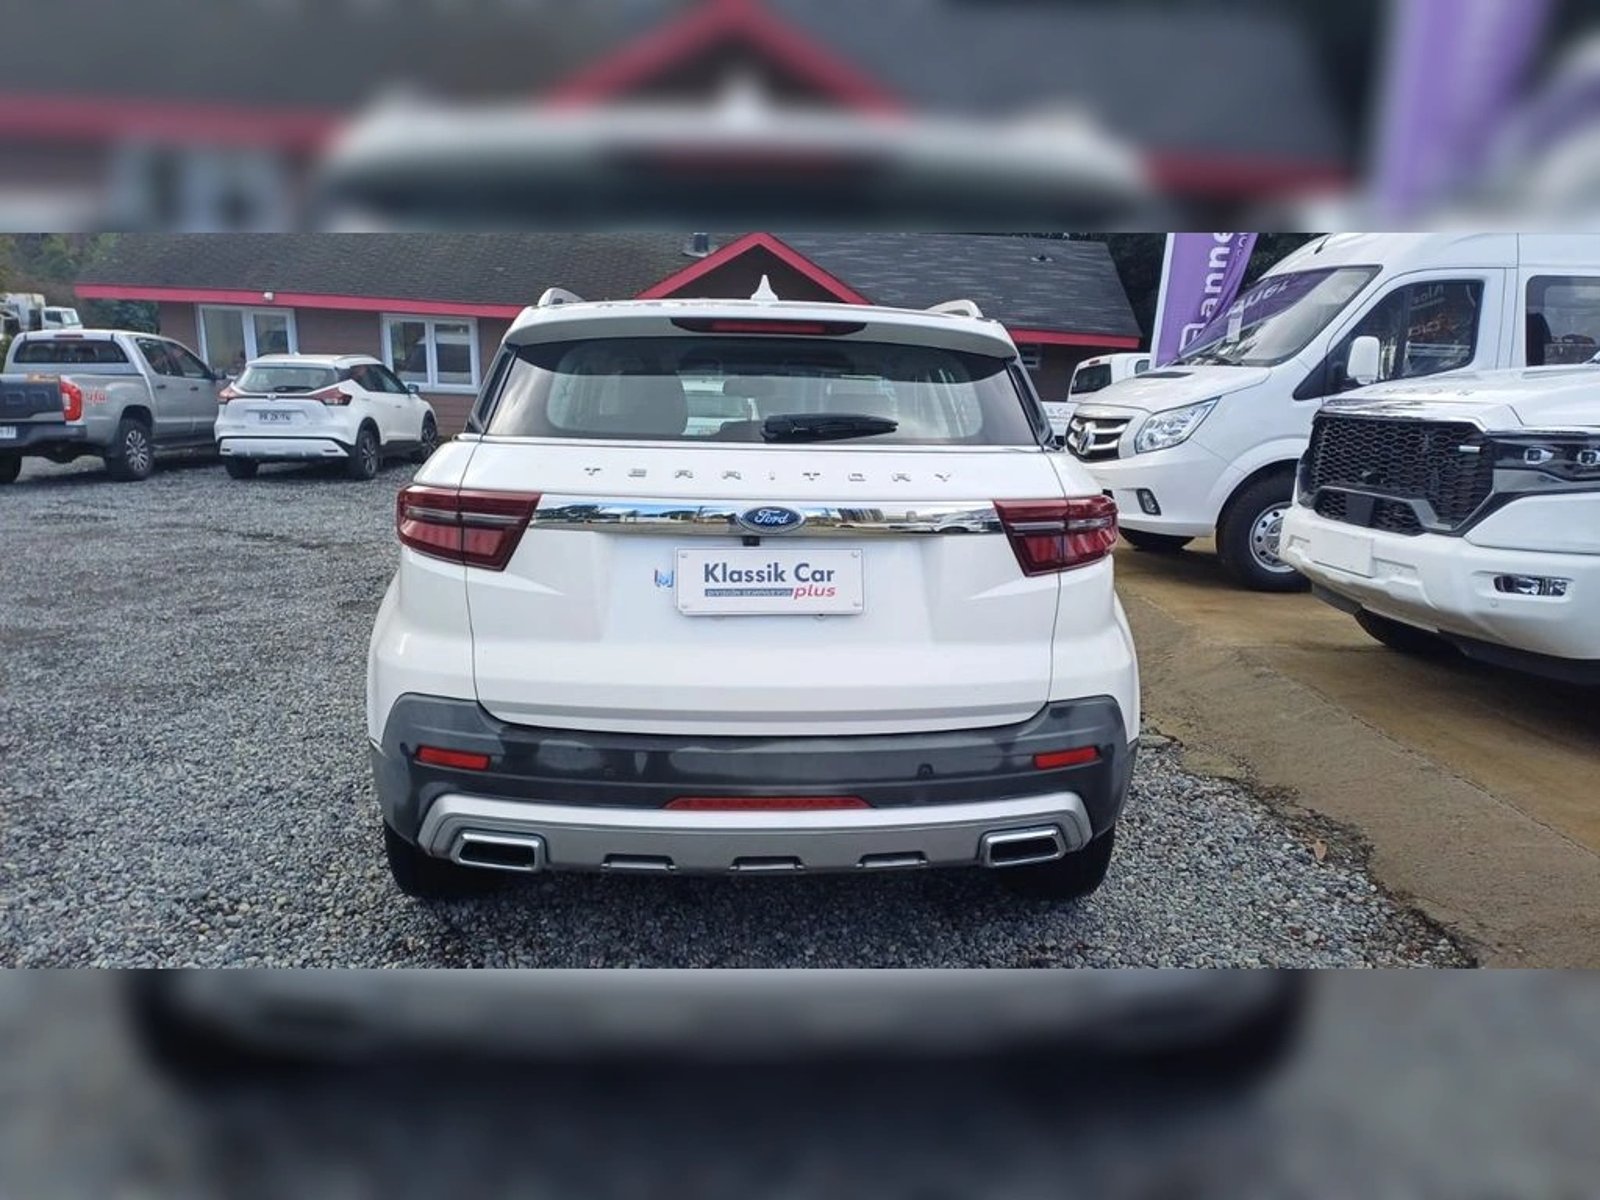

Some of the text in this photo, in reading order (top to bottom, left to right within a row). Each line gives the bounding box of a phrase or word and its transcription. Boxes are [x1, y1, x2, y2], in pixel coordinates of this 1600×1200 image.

[584, 467, 952, 482] TERRITORY
[754, 508, 788, 525] Ford
[704, 562, 835, 583] Klassik Car
[793, 584, 836, 600] plus
